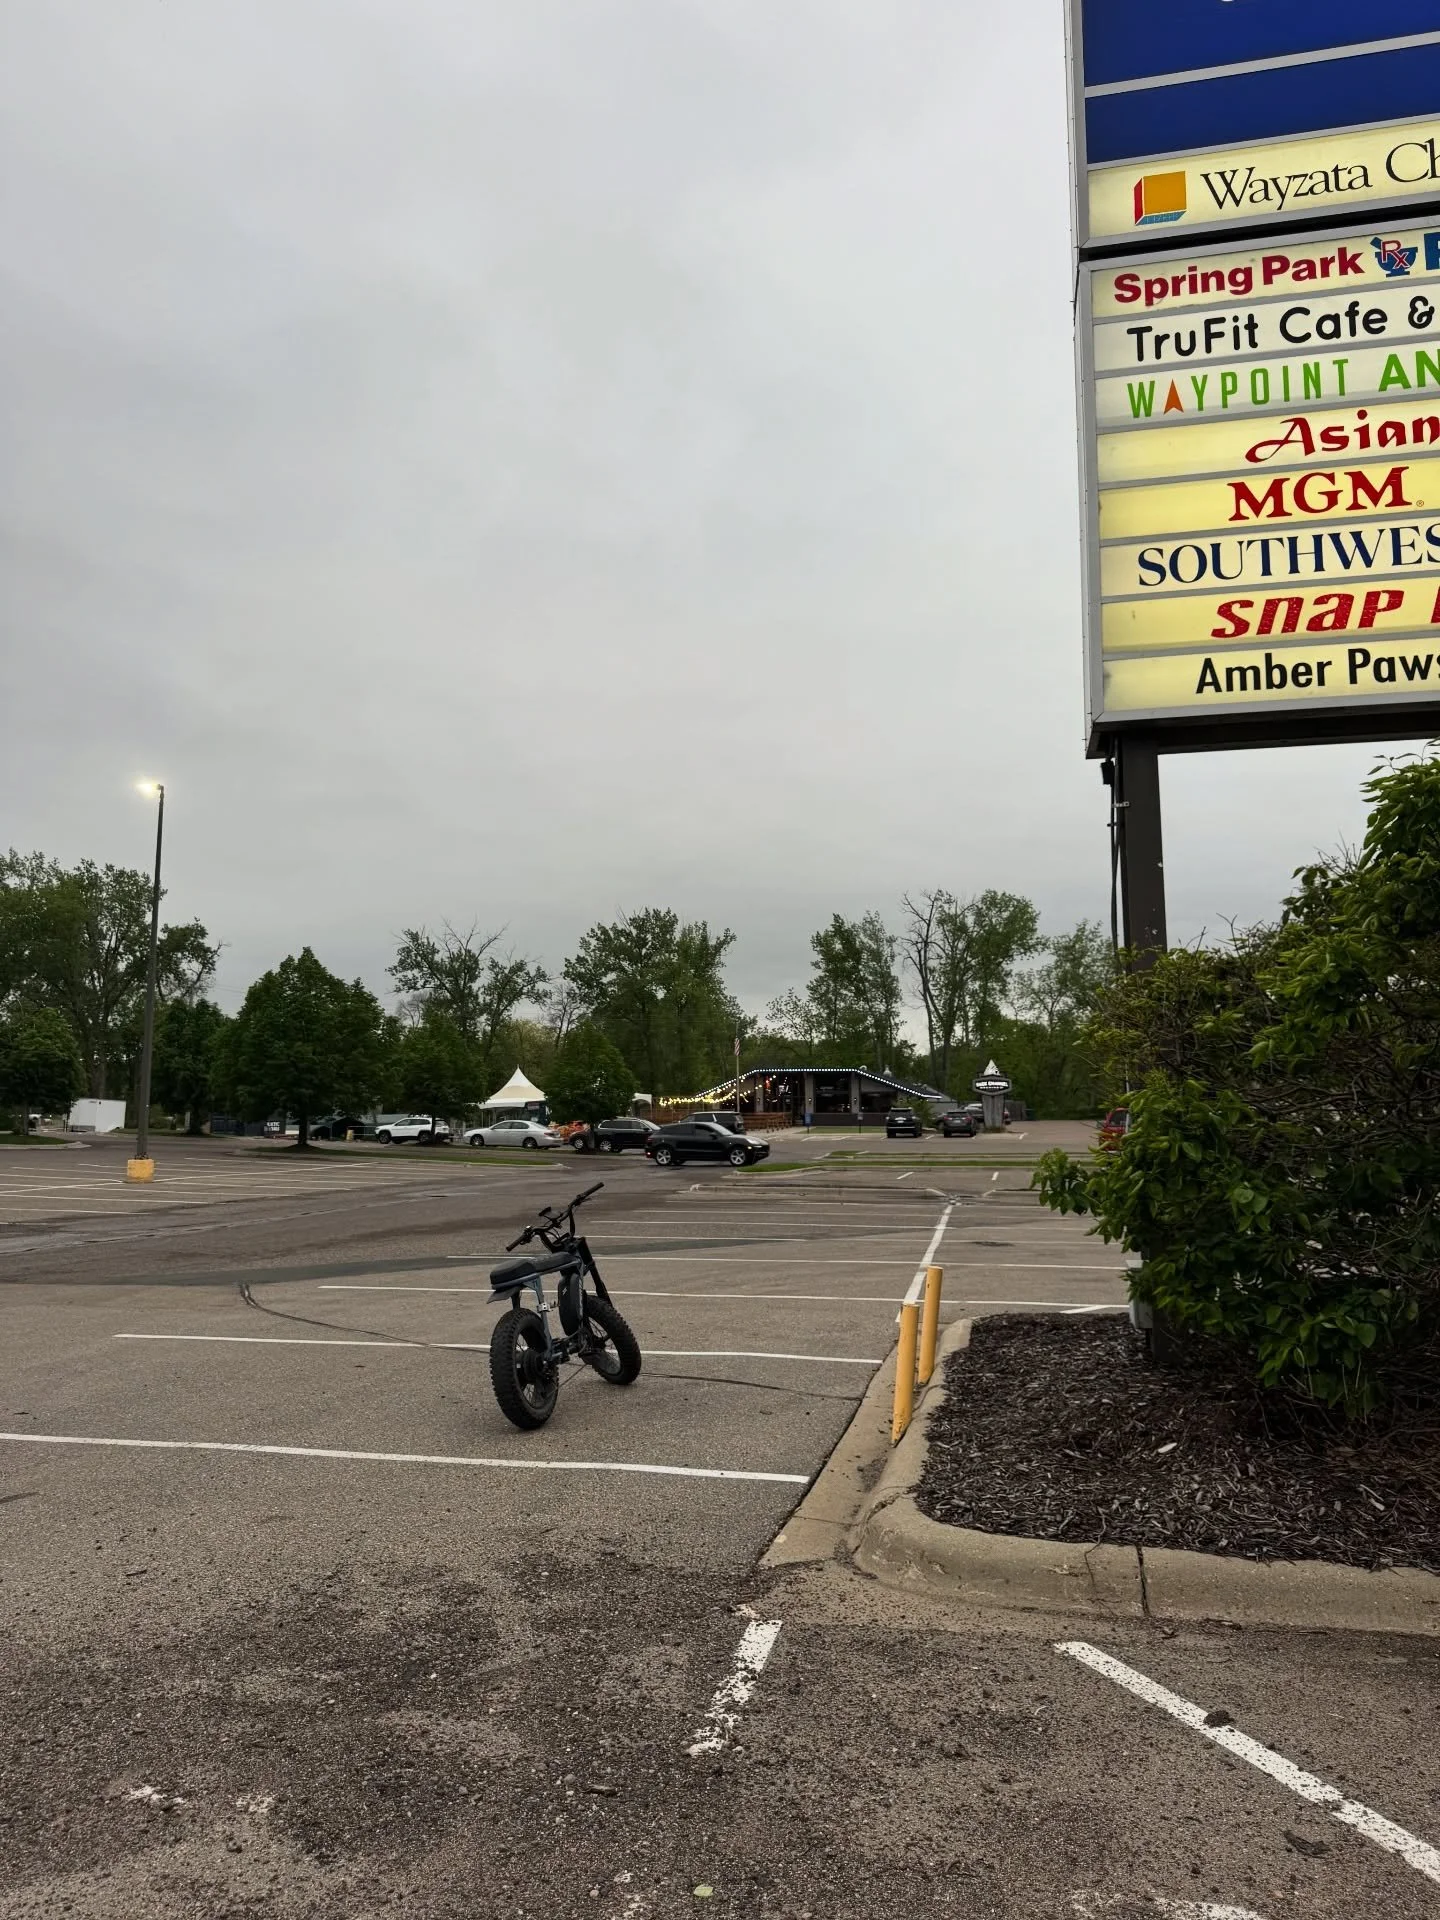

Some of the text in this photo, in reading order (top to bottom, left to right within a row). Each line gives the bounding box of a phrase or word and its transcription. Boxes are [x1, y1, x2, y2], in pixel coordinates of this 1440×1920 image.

[1200, 164, 1373, 211] Wayzata
[1113, 265, 1253, 307] Spring
[1262, 247, 1365, 285] Park
[1127, 295, 1435, 362] TruFit Cafe &
[1127, 358, 1350, 418] WAYPOINT
[1245, 409, 1440, 464] Asian
[1210, 589, 1405, 639] snap
[1195, 652, 1333, 694] Amber
